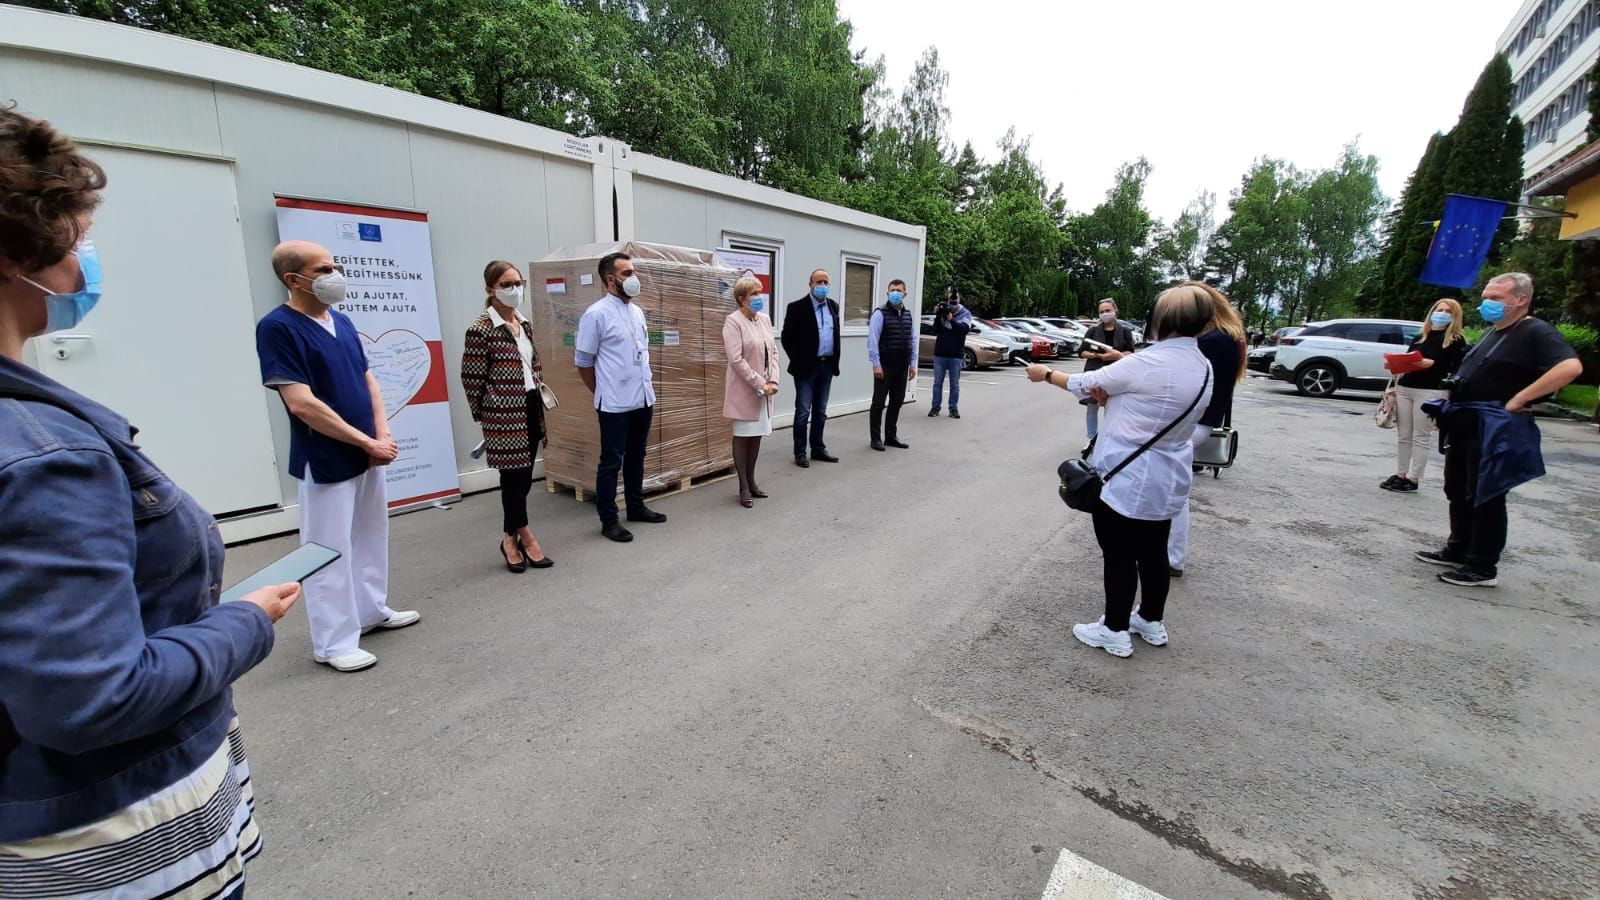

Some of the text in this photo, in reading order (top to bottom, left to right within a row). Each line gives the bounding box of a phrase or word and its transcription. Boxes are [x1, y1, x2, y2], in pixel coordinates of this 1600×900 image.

[333, 254, 399, 268] EGÍTETTEK,
[346, 269, 423, 281] EGÍTHESSÜNK
[363, 291, 408, 301] AJUTAT,
[338, 304, 417, 313] PUTEM AJUTA
